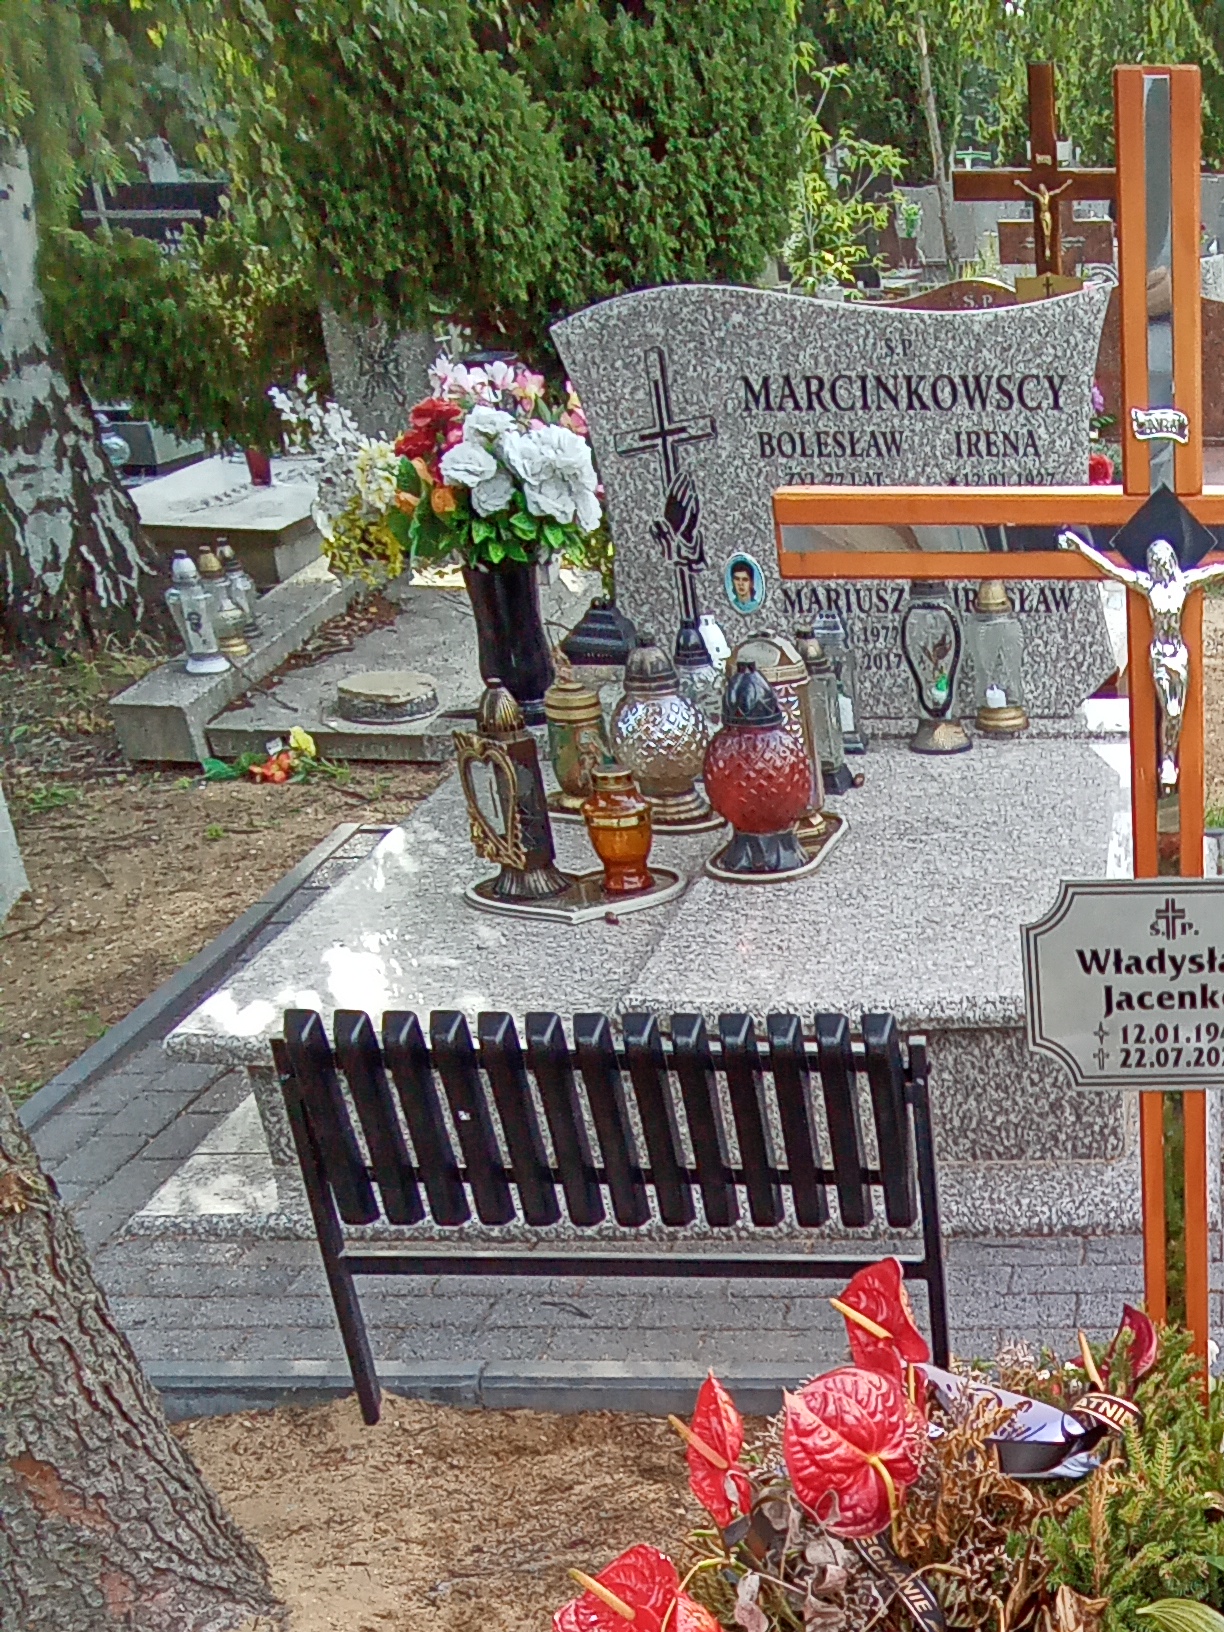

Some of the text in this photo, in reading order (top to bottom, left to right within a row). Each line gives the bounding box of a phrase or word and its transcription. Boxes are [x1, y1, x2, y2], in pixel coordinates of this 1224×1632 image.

[741, 374, 1068, 413] MARCINKOWSCY
[757, 429, 1042, 459] BOLESŁAW IRENA
[782, 587, 905, 614] MARIUSZ
